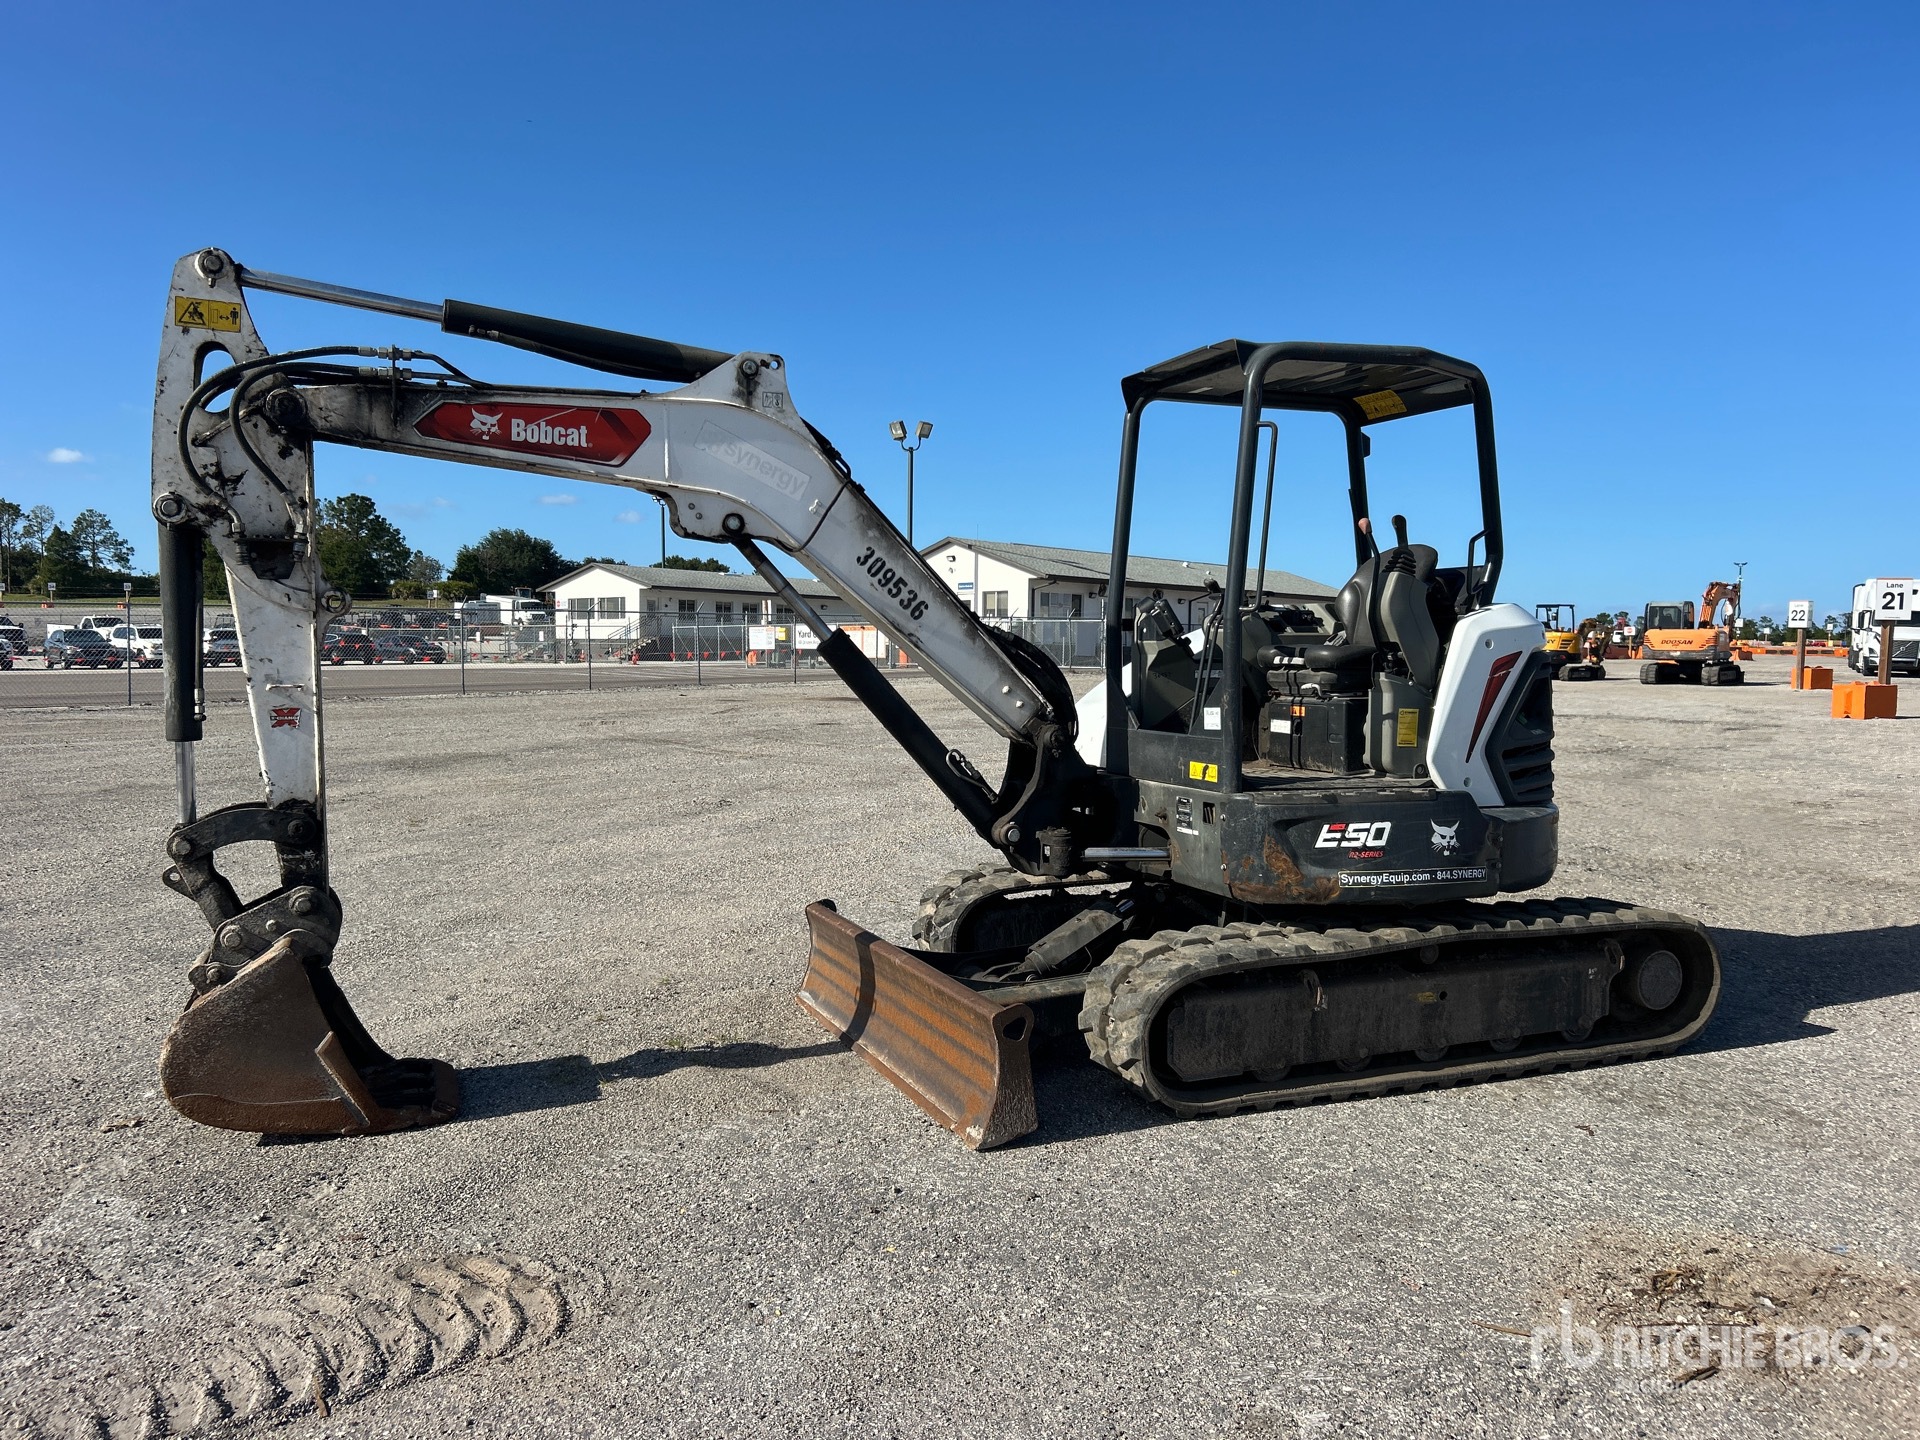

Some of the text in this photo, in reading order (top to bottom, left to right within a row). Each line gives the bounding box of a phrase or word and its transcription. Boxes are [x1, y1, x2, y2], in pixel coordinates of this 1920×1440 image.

[511, 418, 588, 448] Bobcat
[723, 440, 808, 496] synergy
[856, 546, 929, 621] 309536
[1881, 591, 1905, 610] 21
[1791, 609, 1806, 621] 22
[797, 630, 811, 639] Yard
[1314, 821, 1392, 849] E50
[1340, 868, 1487, 887] SynergyEquip.com 844.SYNERGY
